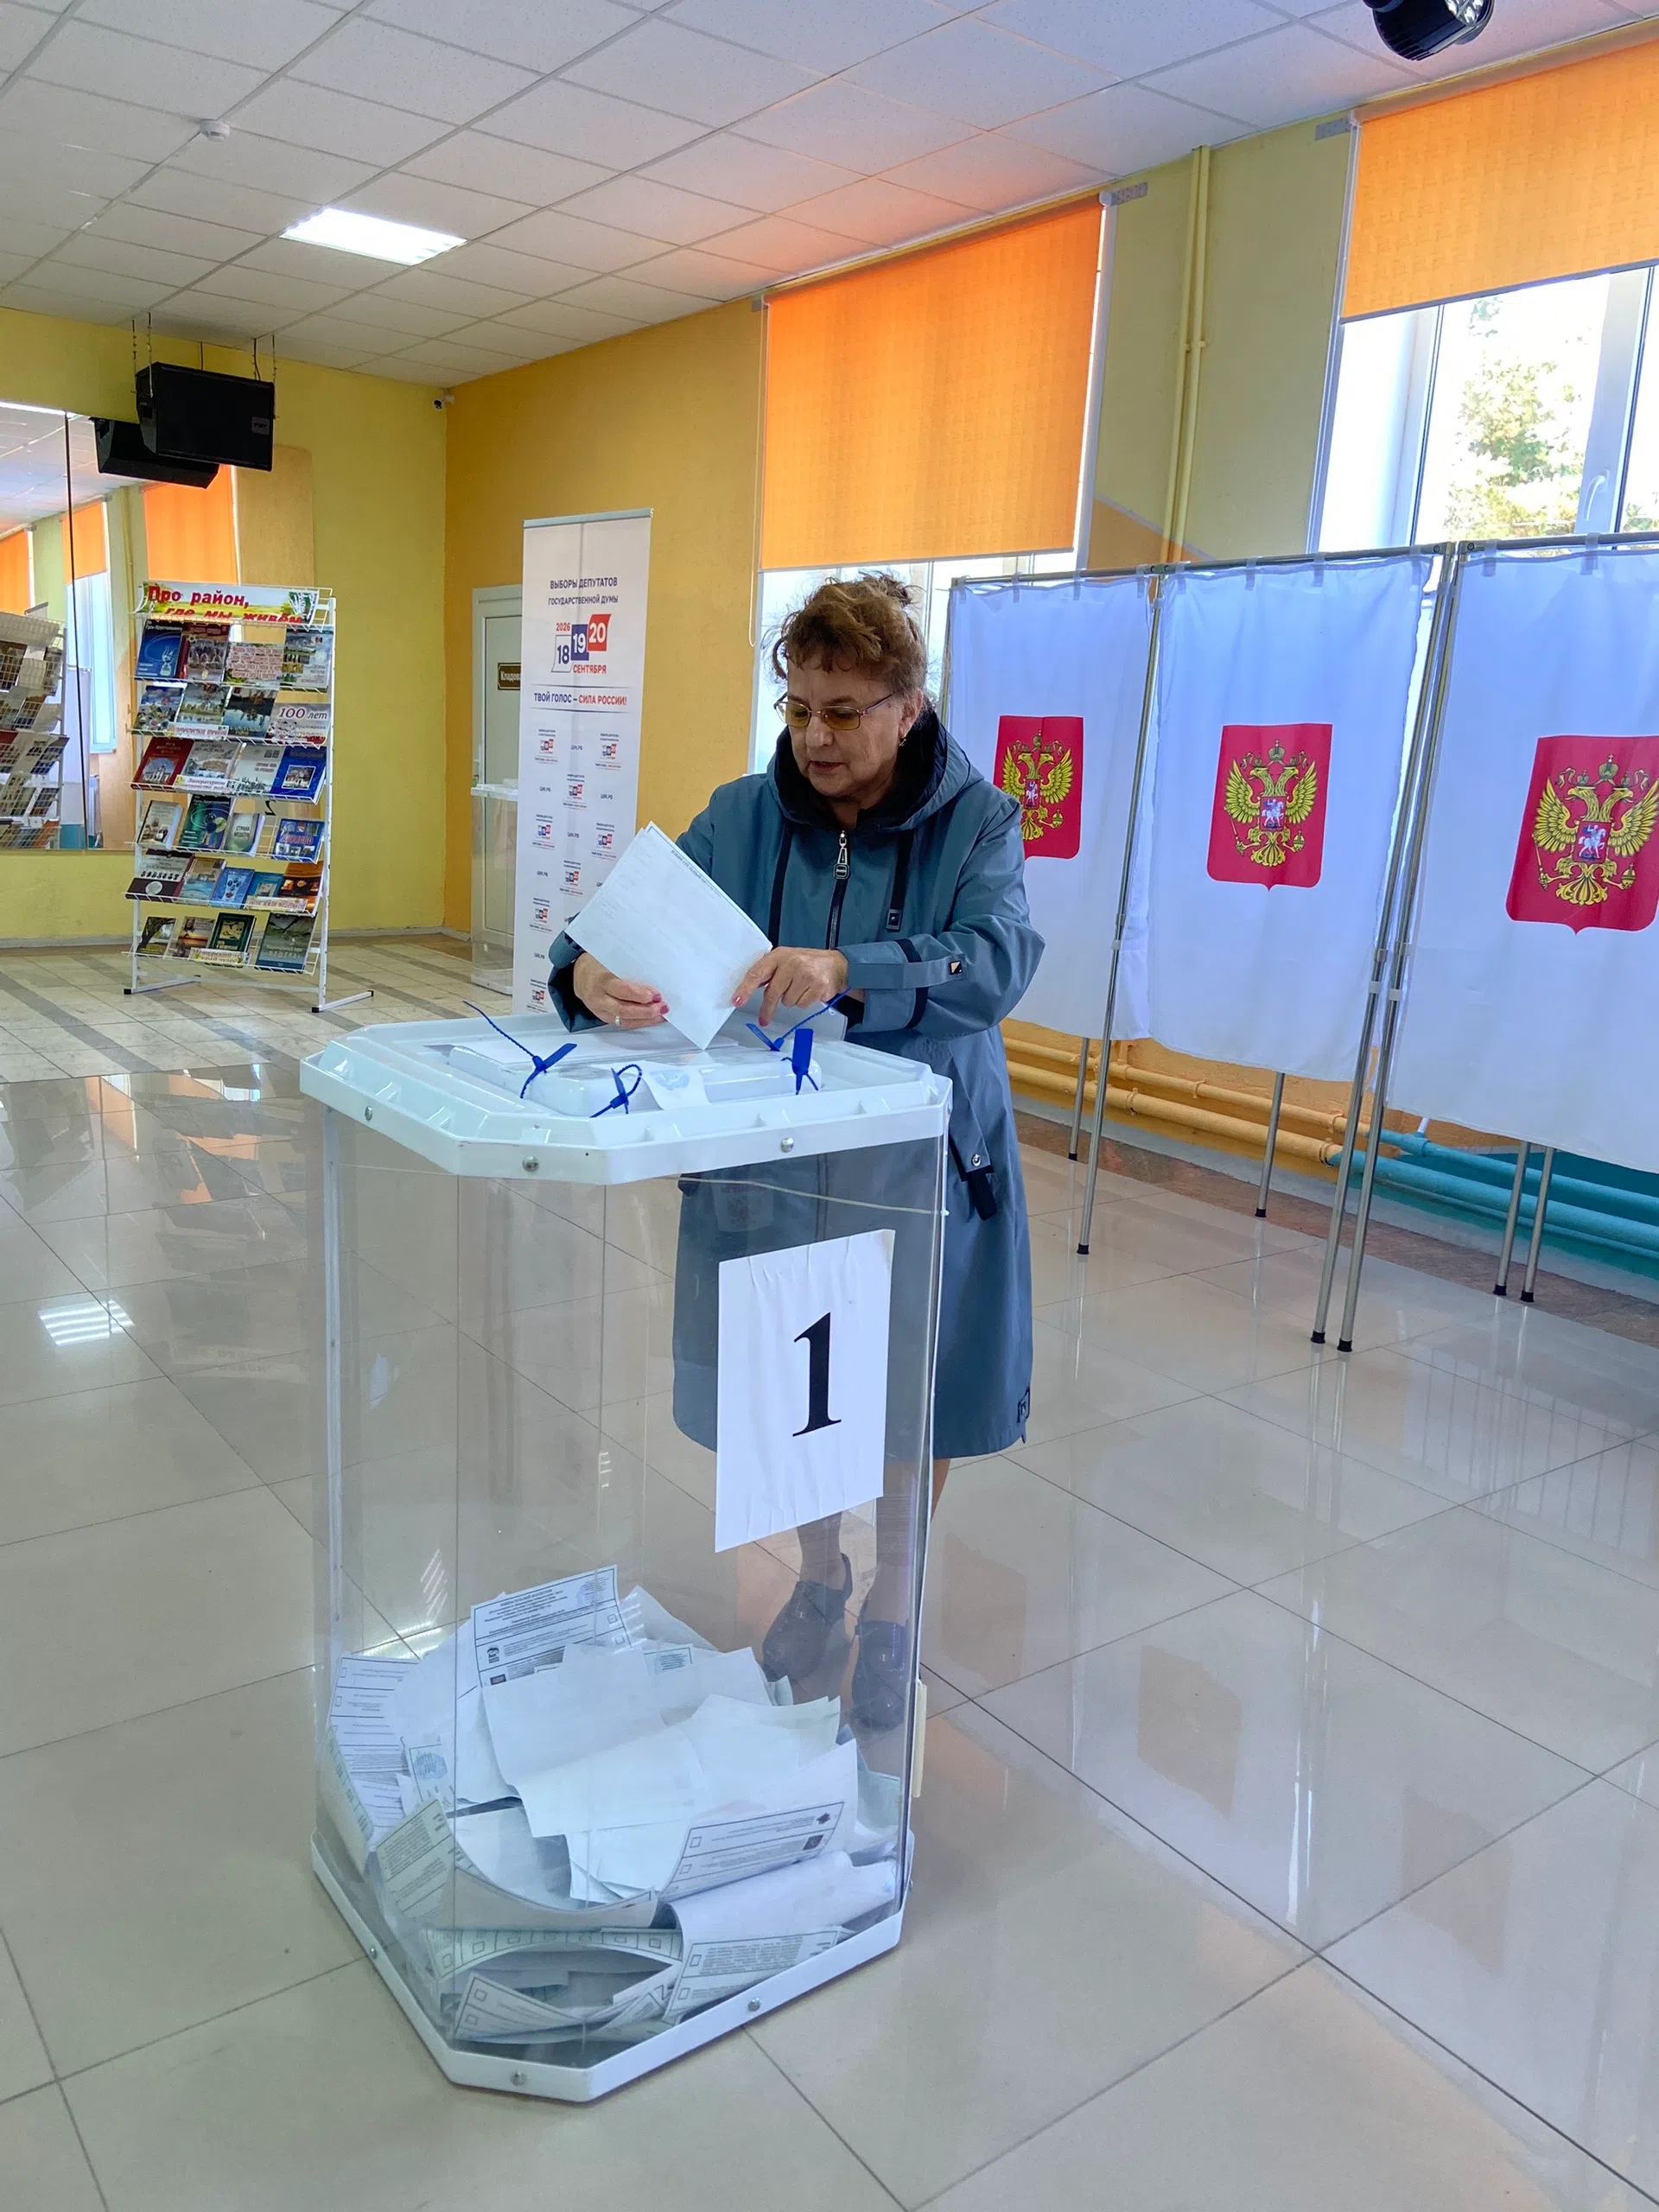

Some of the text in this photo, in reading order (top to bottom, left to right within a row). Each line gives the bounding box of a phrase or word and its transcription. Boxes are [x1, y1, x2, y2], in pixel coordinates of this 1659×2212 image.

[550, 576, 618, 589] ВЫБОРЫ ДЕПУТАТОВ
[148, 584, 250, 609] Про район,
[548, 594, 619, 606] ГОСУДАРСТВЕННОЙ ДУМЫ
[556, 622, 570, 632] 2026
[588, 622, 607, 643] 20
[573, 632, 587, 654] 19
[556, 645, 570, 664] 18
[573, 664, 607, 674] СЕНТЯБРЯ
[534, 691, 550, 702] ТВОЙ
[551, 693, 572, 703] ГОЛОС
[578, 694, 596, 704] СИЛА
[597, 695, 627, 706] РОССИИ!
[278, 708, 306, 719] 100
[792, 1312, 842, 1438] 1
